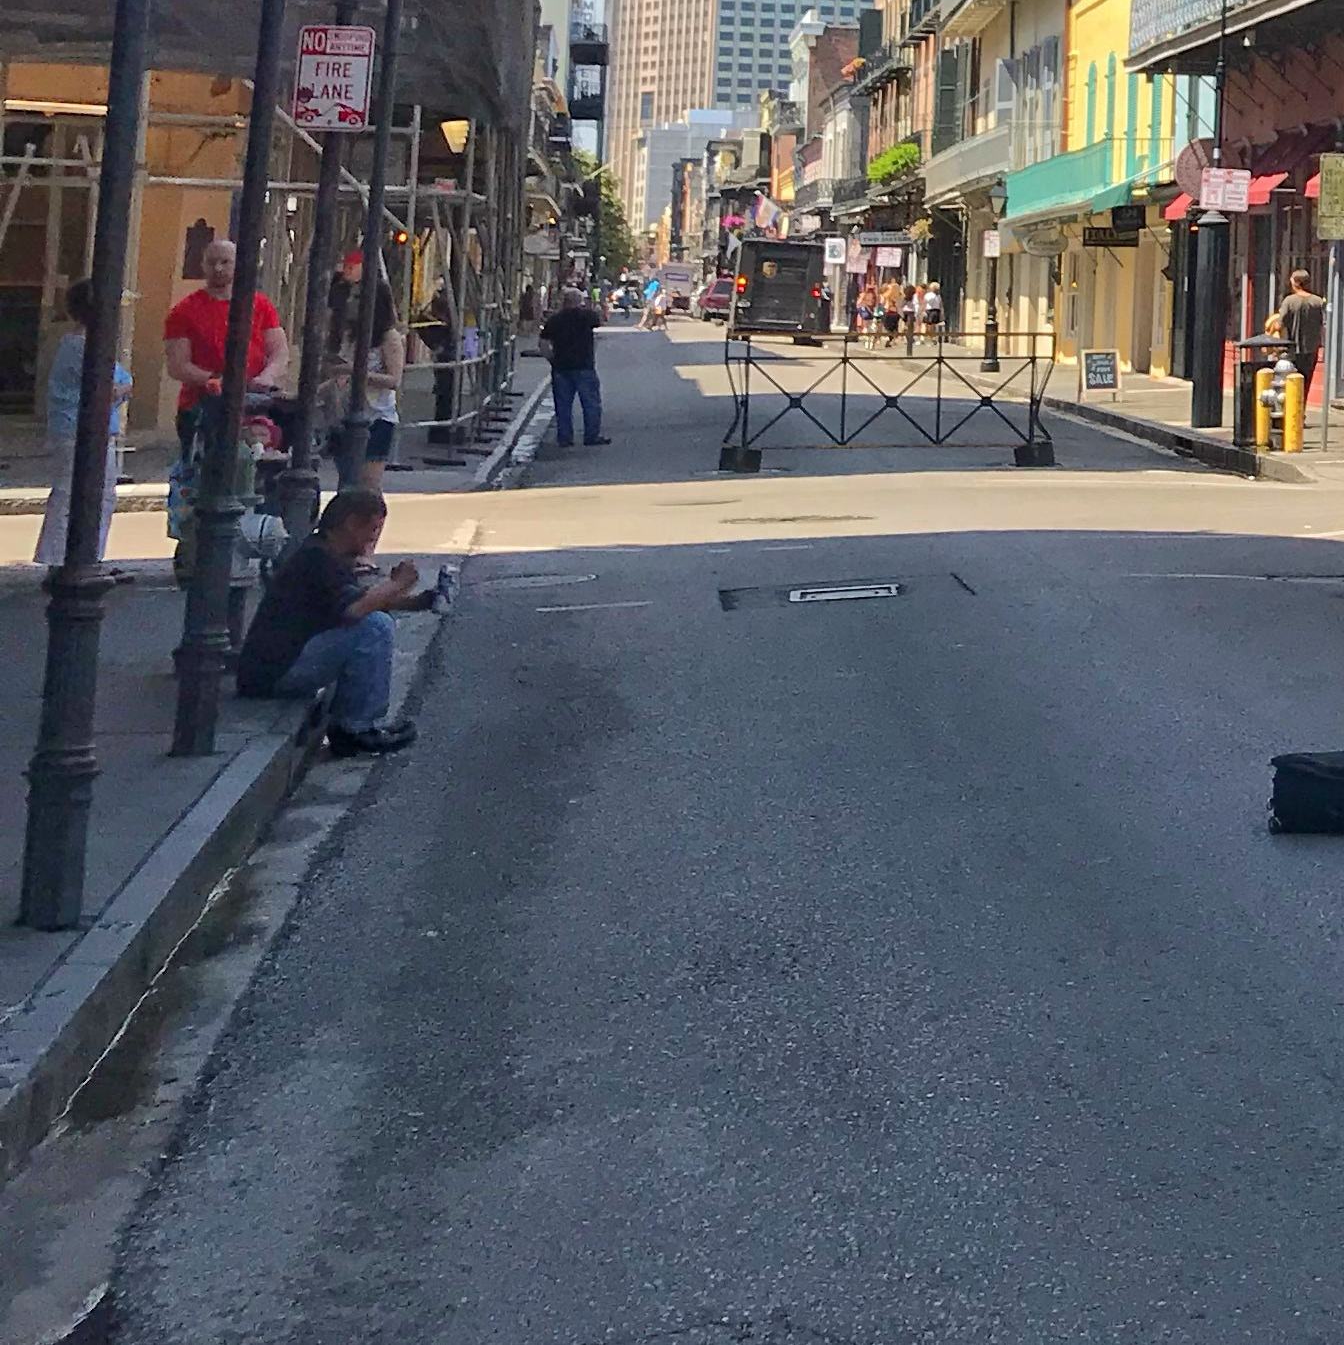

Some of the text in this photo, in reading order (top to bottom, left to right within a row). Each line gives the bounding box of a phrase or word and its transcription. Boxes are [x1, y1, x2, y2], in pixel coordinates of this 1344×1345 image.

[302, 31, 326, 52] NO
[315, 61, 353, 78] FIRE
[311, 83, 354, 100] LANE
